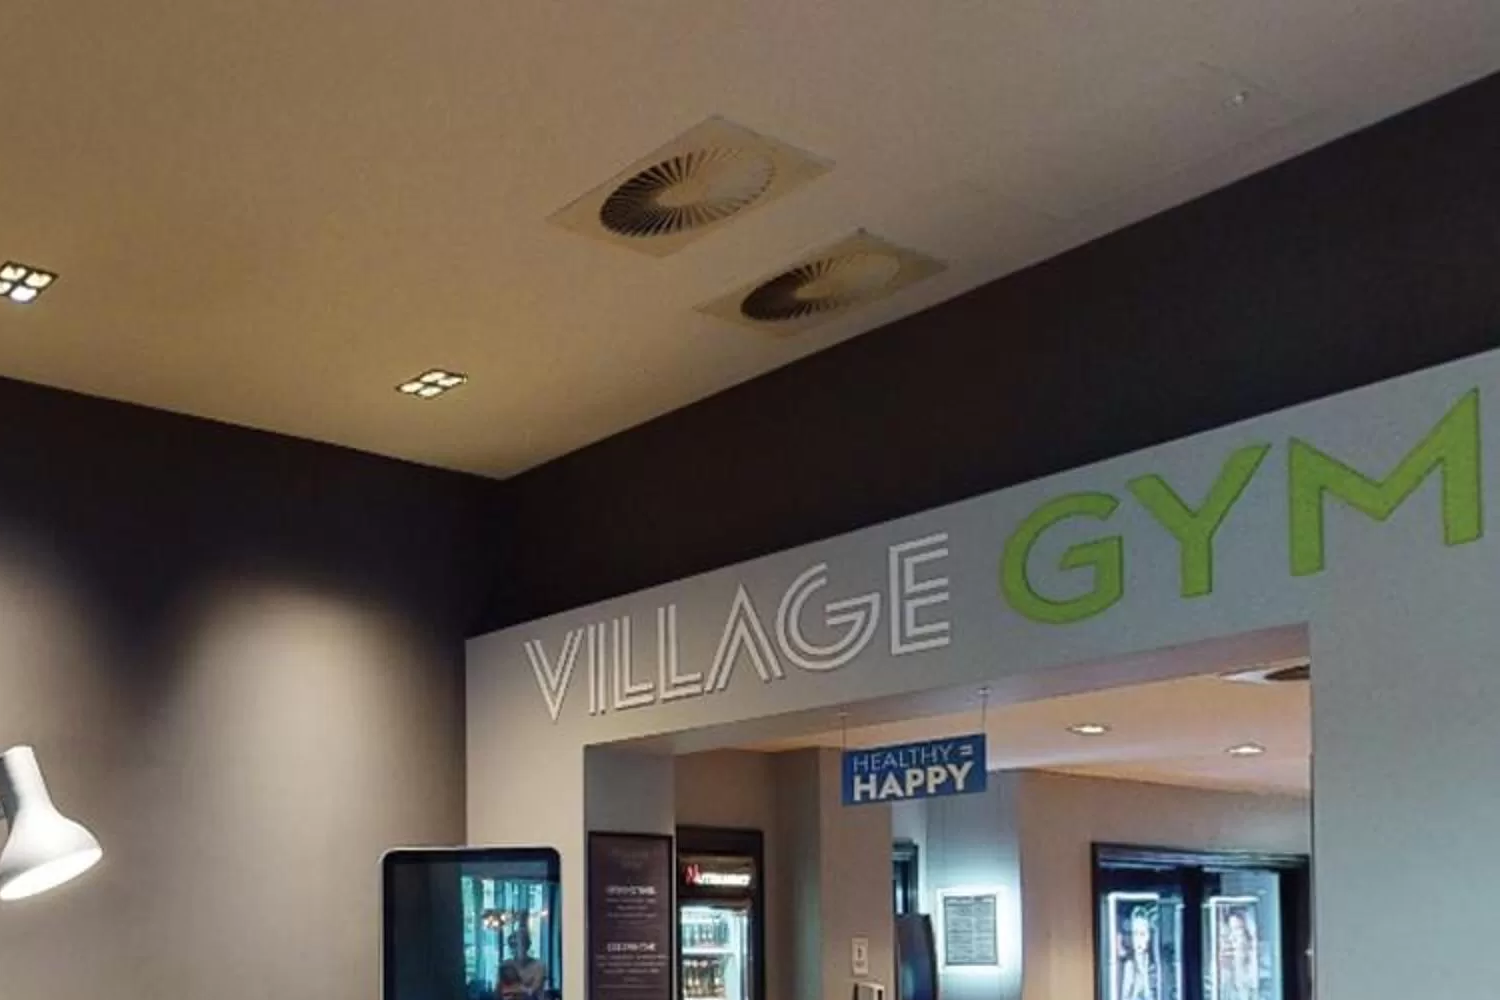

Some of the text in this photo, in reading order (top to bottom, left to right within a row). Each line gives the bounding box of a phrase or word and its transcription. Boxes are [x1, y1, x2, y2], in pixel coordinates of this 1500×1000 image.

[523, 385, 1484, 723] VILLAGE GYM
[852, 743, 953, 773] HEALTHY
[853, 761, 975, 802] HAPPY
